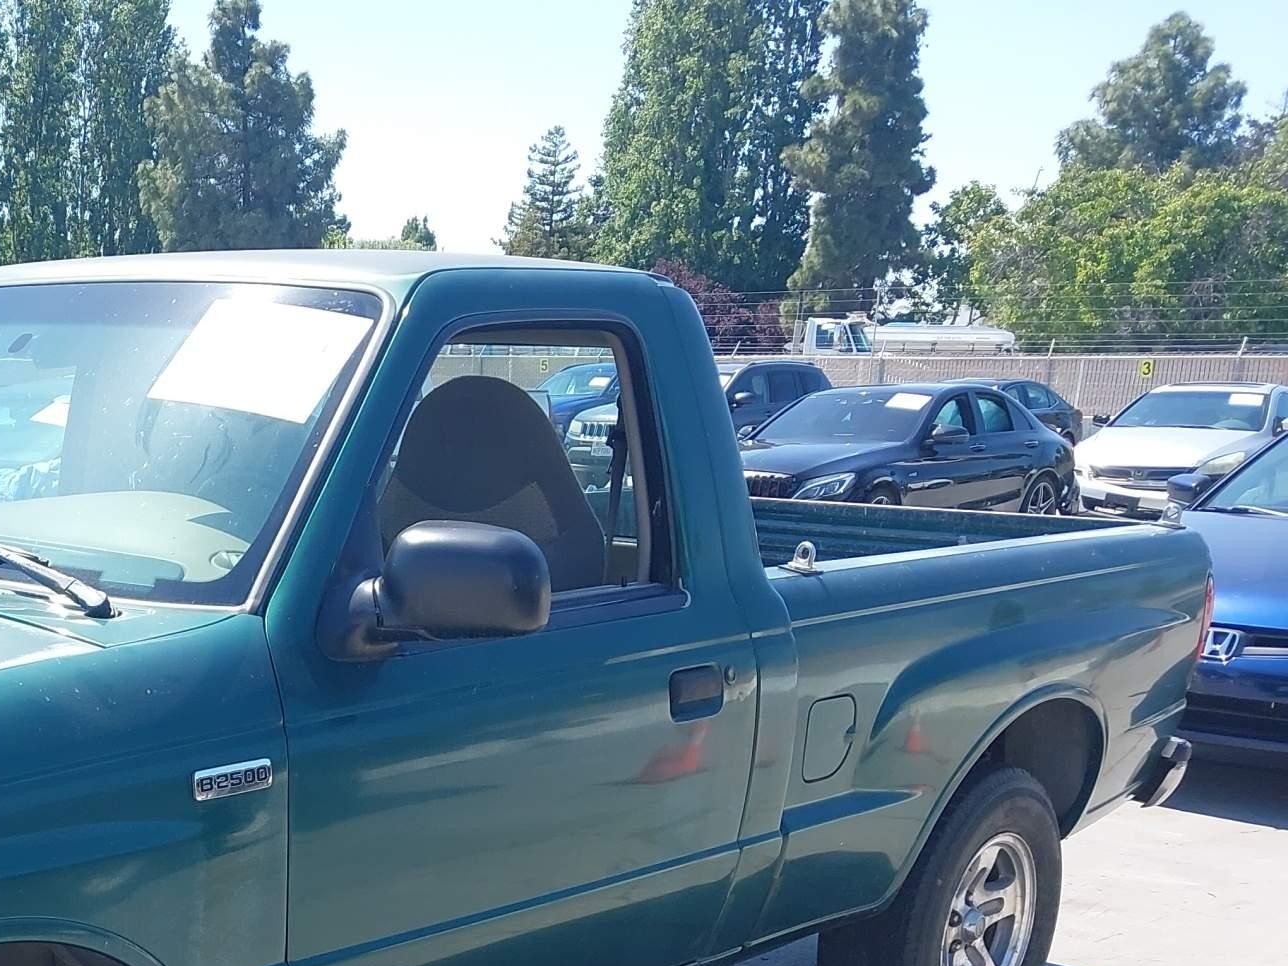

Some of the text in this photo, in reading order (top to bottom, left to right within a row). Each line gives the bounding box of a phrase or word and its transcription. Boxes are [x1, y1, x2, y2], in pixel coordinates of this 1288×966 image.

[541, 360, 548, 371] 5
[1142, 361, 1151, 375] 3
[199, 766, 268, 792] B2500
